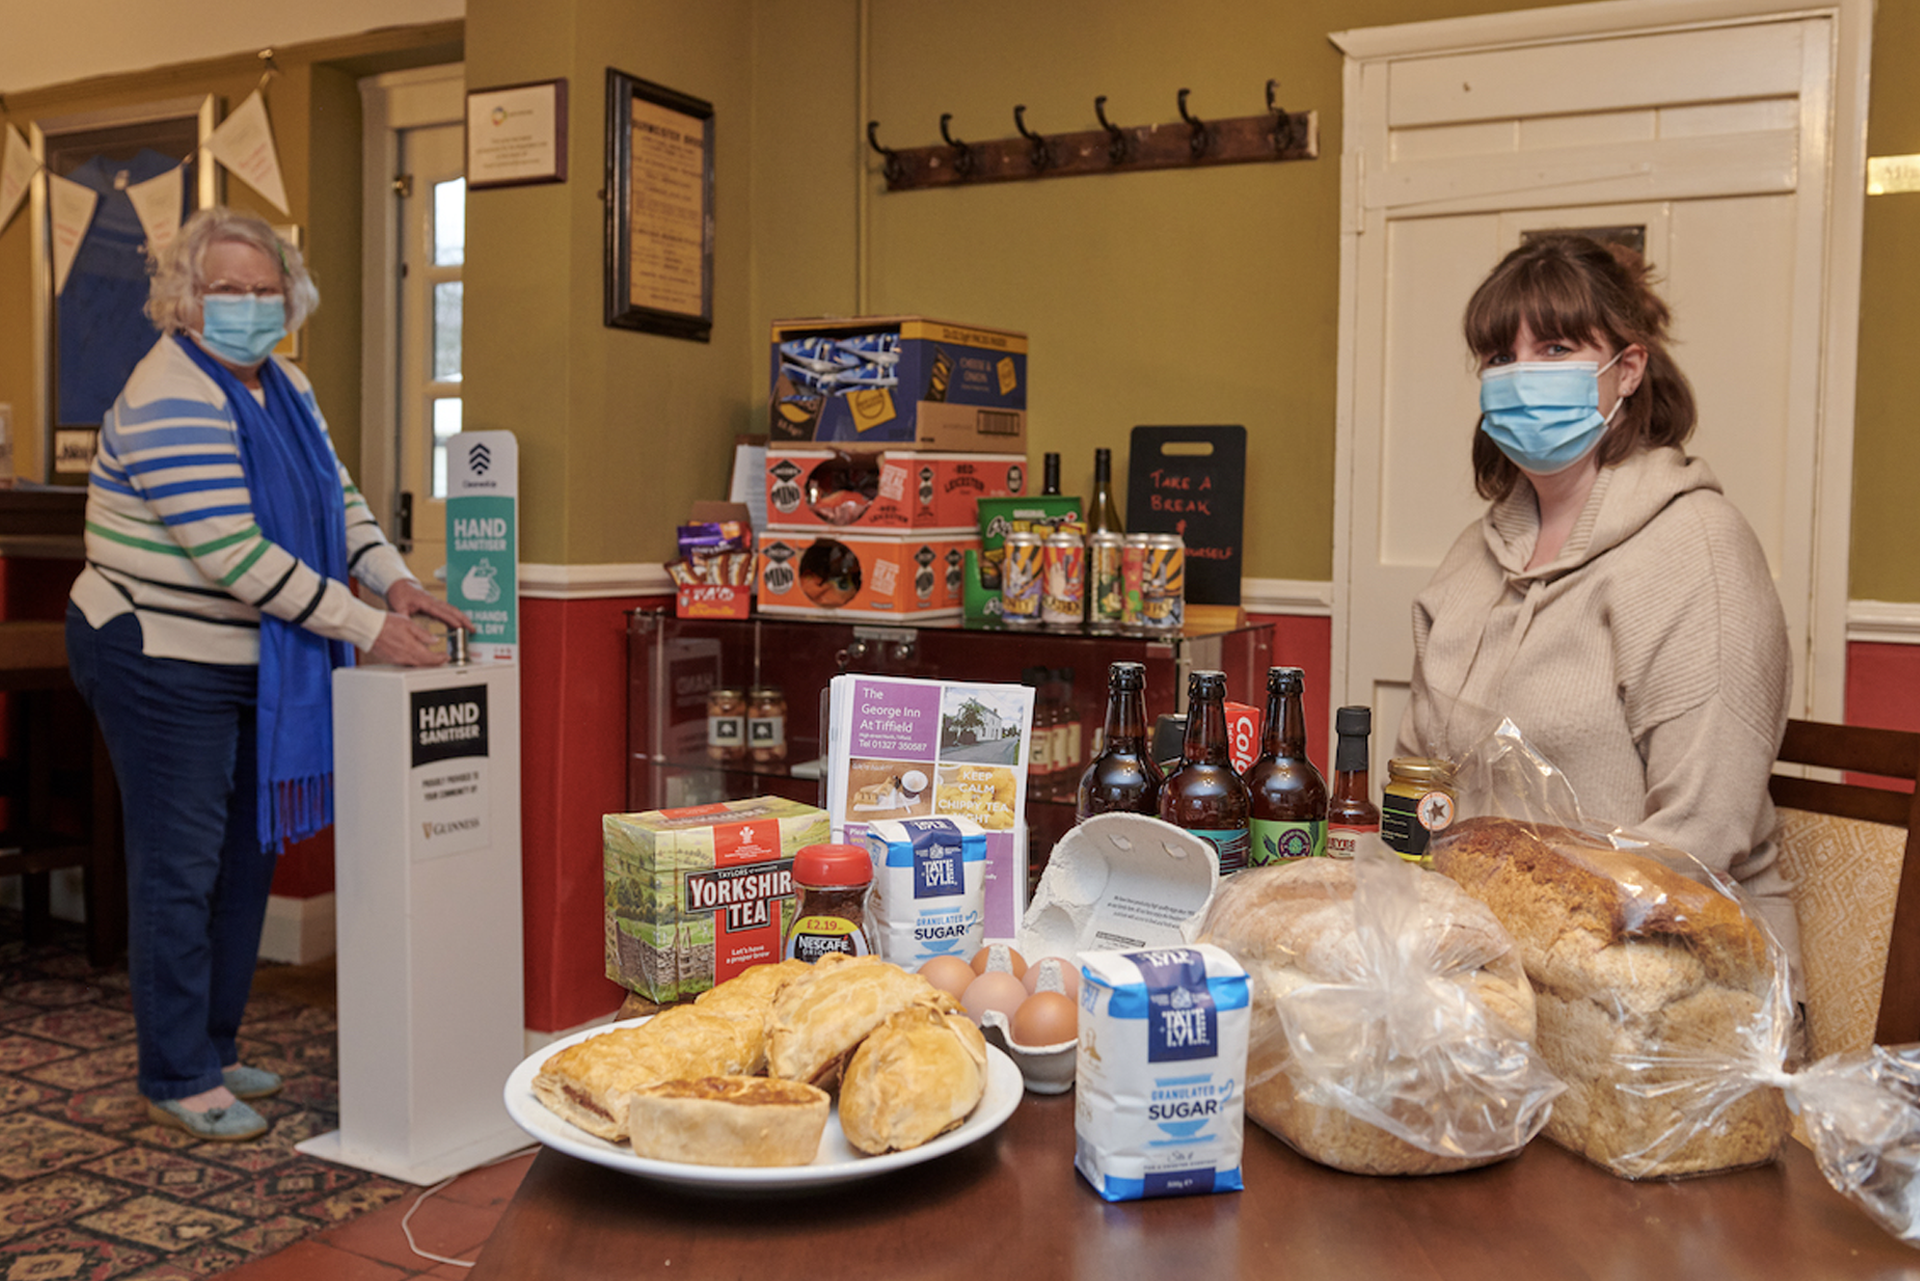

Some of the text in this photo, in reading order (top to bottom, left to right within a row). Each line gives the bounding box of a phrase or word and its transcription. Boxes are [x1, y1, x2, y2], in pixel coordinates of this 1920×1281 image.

[956, 464, 974, 475] RED
[944, 477, 985, 494] LEICESTER
[1150, 468, 1212, 491] TAKE A
[1150, 494, 1211, 516] BREAK
[454, 518, 507, 538] HAND
[454, 538, 507, 551] SANITISER
[475, 611, 509, 623] HANDS
[485, 623, 506, 635] DRY
[863, 687, 884, 700] The
[419, 702, 480, 730] HAND
[861, 703, 921, 719] George Inn
[860, 719, 914, 733] At Tiffield
[419, 724, 480, 746] SANITISER
[859, 739, 871, 748] Tel
[872, 740, 897, 749] 01327
[1230, 716, 1254, 776] Colg
[963, 771, 993, 782] KEEP
[958, 782, 995, 794] CALM
[938, 799, 1009, 812] CHIPPY TEA
[433, 817, 480, 836] GUINNESS
[922, 859, 954, 873] TATE
[718, 869, 748, 879] TAYLORS
[925, 873, 956, 888] LYLE
[690, 870, 793, 908] YORKSHIR
[729, 900, 767, 928] TEA
[917, 914, 963, 927] GRANULATED
[807, 919, 837, 931] £2.19
[914, 924, 965, 941] SUGAR
[731, 944, 764, 956] Let's have
[731, 954, 753, 965] proper
[754, 950, 770, 959] brew
[1162, 1008, 1206, 1027] TATE
[1166, 1026, 1207, 1048] LYLE
[1151, 1084, 1216, 1102] GRANULATED
[1148, 1099, 1218, 1121] SUGAR
